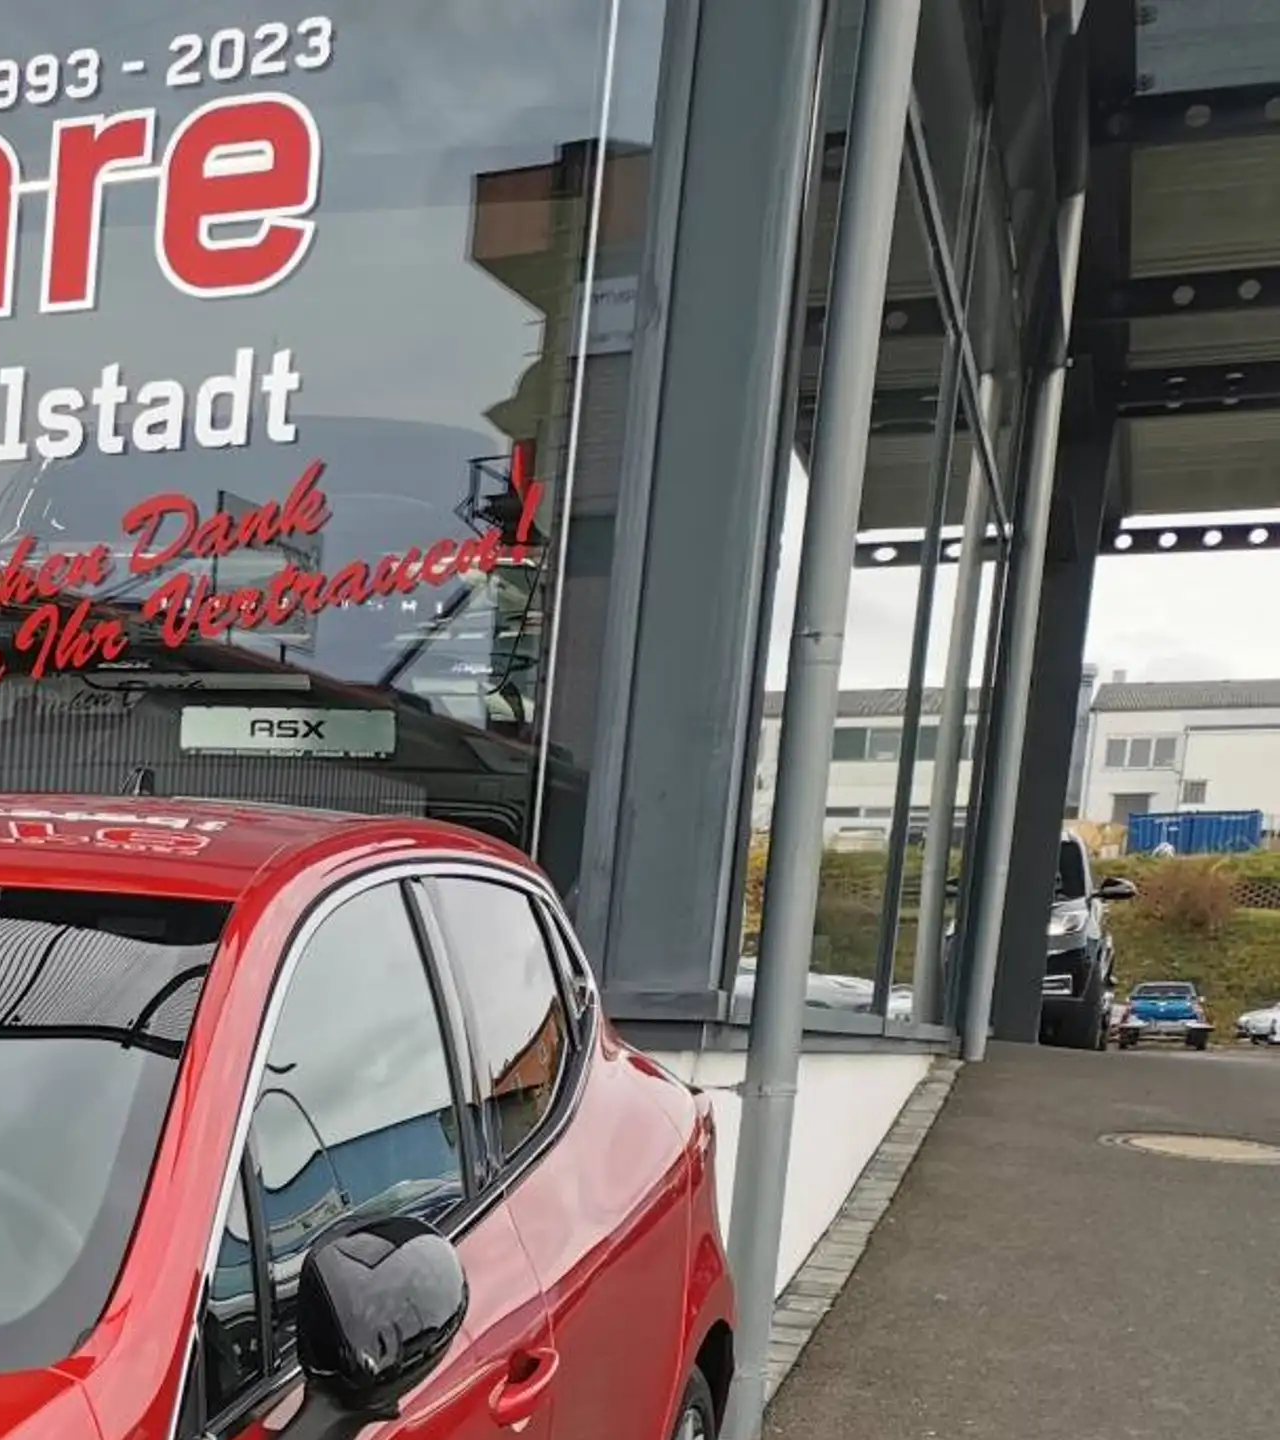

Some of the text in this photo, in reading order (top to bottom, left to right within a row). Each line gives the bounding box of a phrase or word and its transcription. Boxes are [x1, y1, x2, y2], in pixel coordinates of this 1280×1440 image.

[166, 16, 334, 87] 2023
[122, 459, 333, 576] Dank
[16, 598, 130, 681] Ihr
[143, 482, 543, 649] Vertrauen!
[249, 718, 326, 740] ASX
